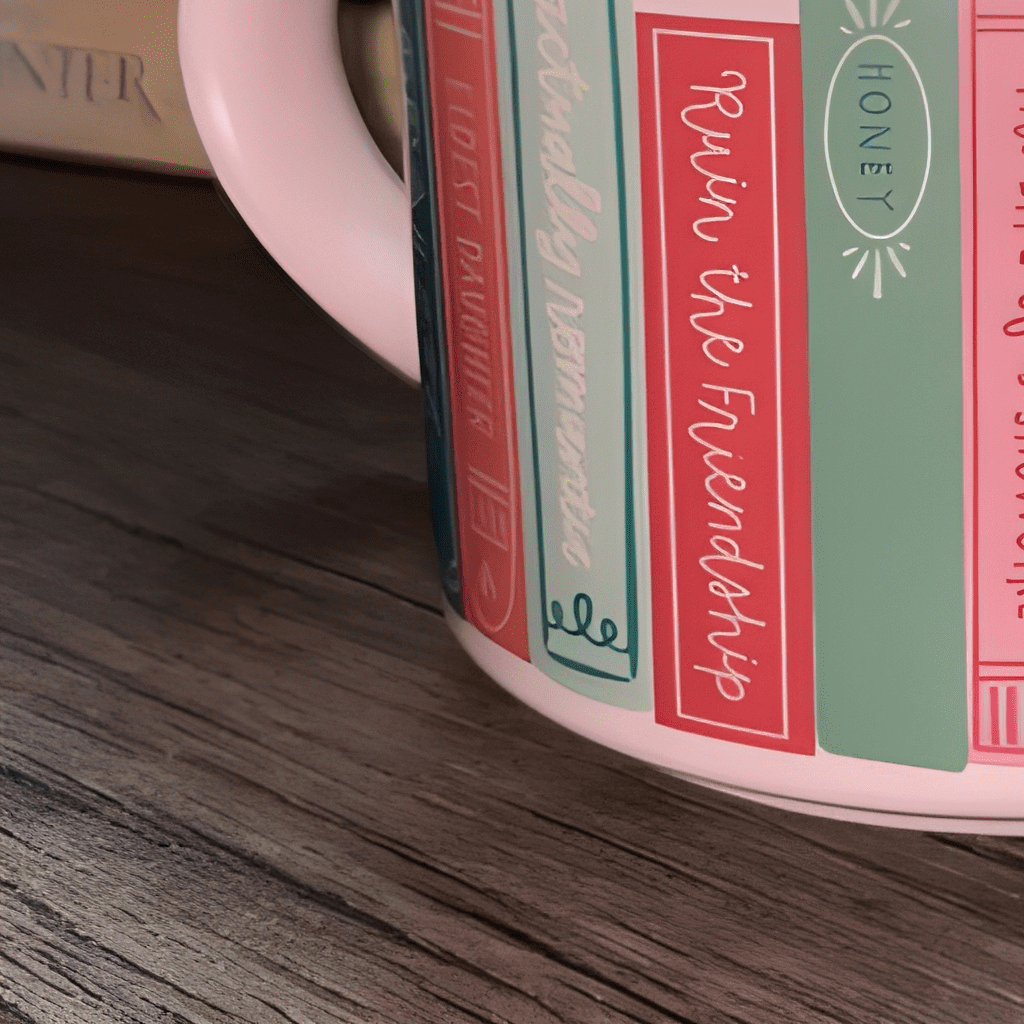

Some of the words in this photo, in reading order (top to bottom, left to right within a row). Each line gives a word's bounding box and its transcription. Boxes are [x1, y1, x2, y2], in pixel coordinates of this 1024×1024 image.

[681, 69, 747, 243] Ruin
[856, 62, 894, 212] HONEY
[691, 263, 751, 369] the
[687, 382, 765, 704] Friendship
